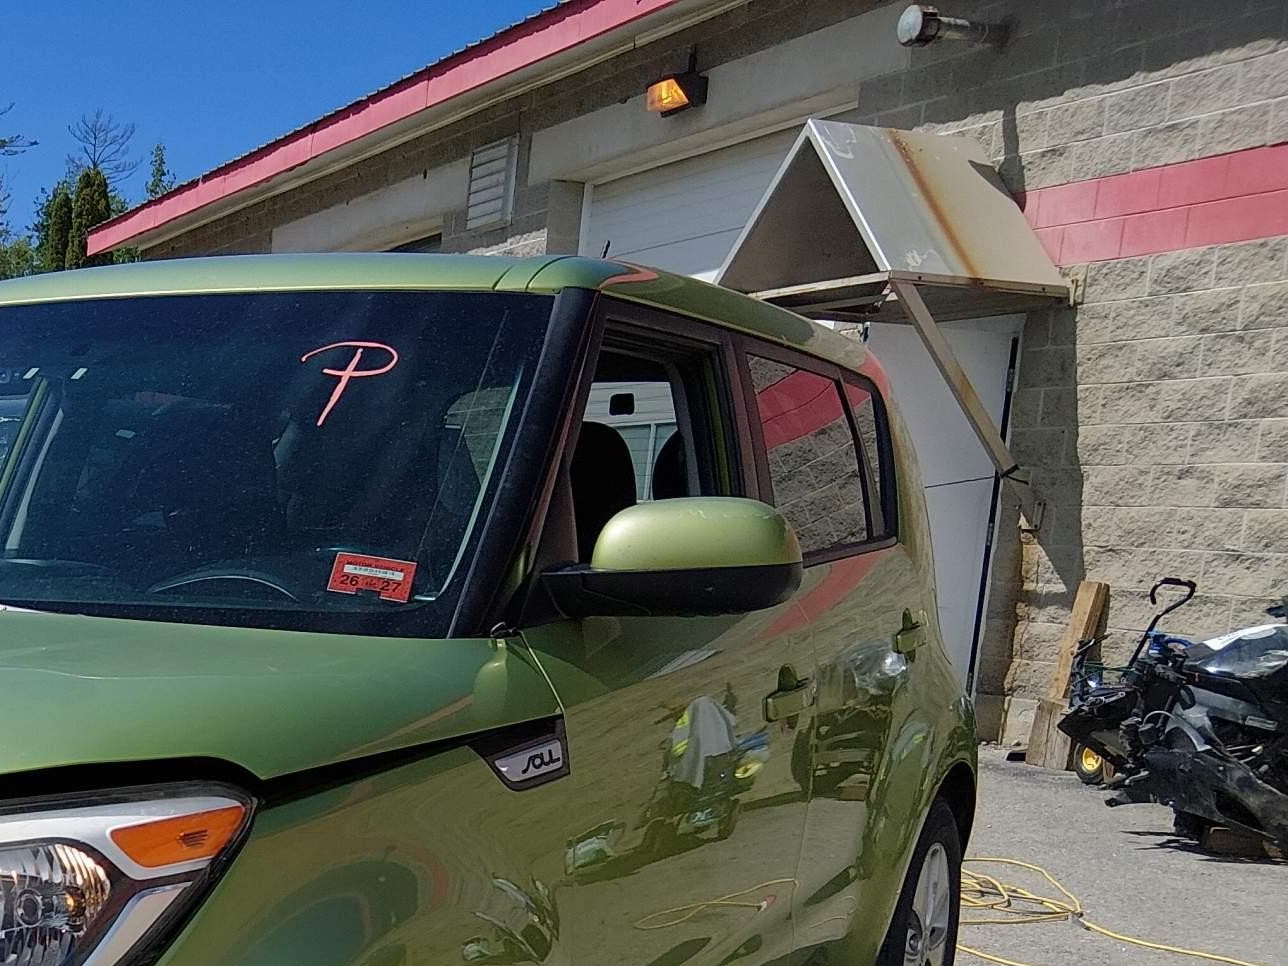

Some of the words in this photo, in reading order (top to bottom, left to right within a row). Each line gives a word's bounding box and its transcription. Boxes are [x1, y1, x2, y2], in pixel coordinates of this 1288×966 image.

[301, 341, 398, 427] P
[339, 574, 359, 586] 26
[380, 581, 402, 592] 27
